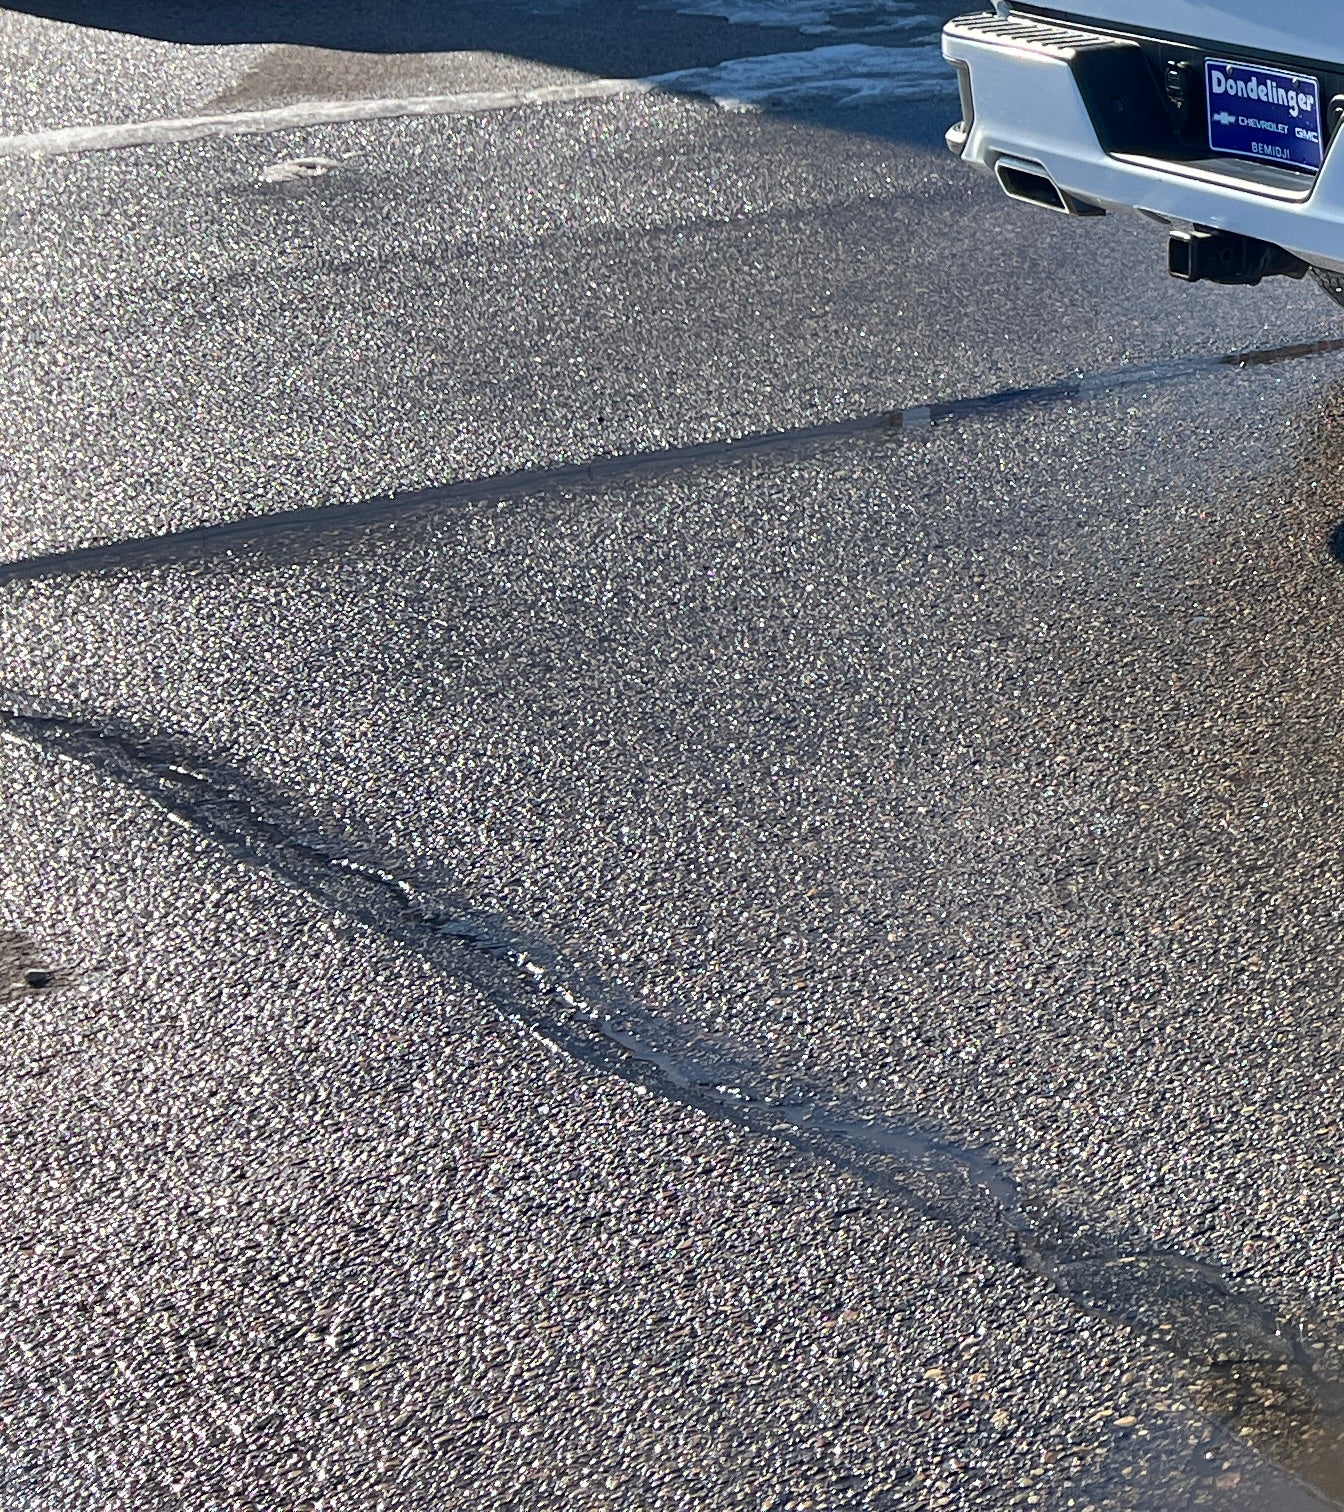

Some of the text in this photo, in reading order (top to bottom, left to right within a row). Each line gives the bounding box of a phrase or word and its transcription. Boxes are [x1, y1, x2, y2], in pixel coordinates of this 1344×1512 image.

[1211, 70, 1314, 117] Dondelinger
[1239, 116, 1319, 143] CHEVROLET GMC
[1251, 141, 1290, 160] BEMIDJI
